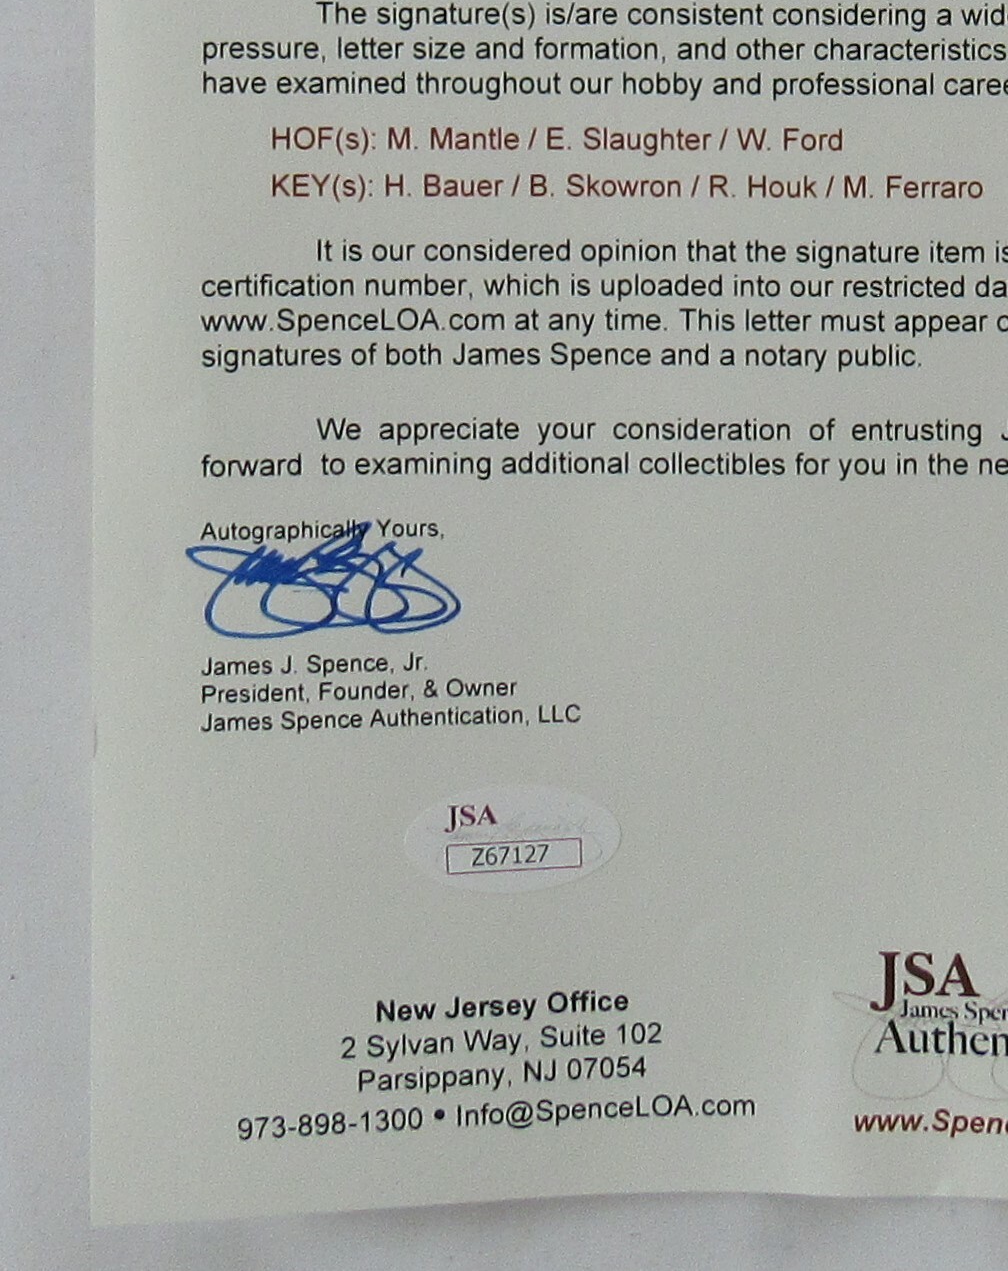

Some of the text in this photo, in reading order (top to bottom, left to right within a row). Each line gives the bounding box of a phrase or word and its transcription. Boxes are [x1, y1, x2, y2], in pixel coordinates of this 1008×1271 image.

[271, 125, 376, 156] HOF(s):
[387, 126, 418, 150] M.
[430, 126, 520, 151] Mantle
[546, 126, 571, 150] E.
[583, 126, 711, 157] Slaughter
[737, 127, 770, 151] W.
[783, 127, 843, 152] Ford
[375, 516, 446, 541] Yours,
[200, 651, 428, 678] James J. Spence, Jr.
[201, 677, 518, 704] President, Founder, & Owner
[200, 703, 581, 734] James Spence Authentication, LLC
[443, 803, 498, 834] JSA
[471, 843, 550, 867] Z67127
[869, 950, 982, 1013] JSA
[376, 989, 629, 1023] New Jersey Office
[899, 998, 960, 1021] James
[340, 1021, 662, 1063] 2 Sylvan Way, Suite 102
[358, 1055, 647, 1094] Parsippany, NJ 07054
[237, 1091, 755, 1141] 973-898-1300 Info@SpenceLOA.com
